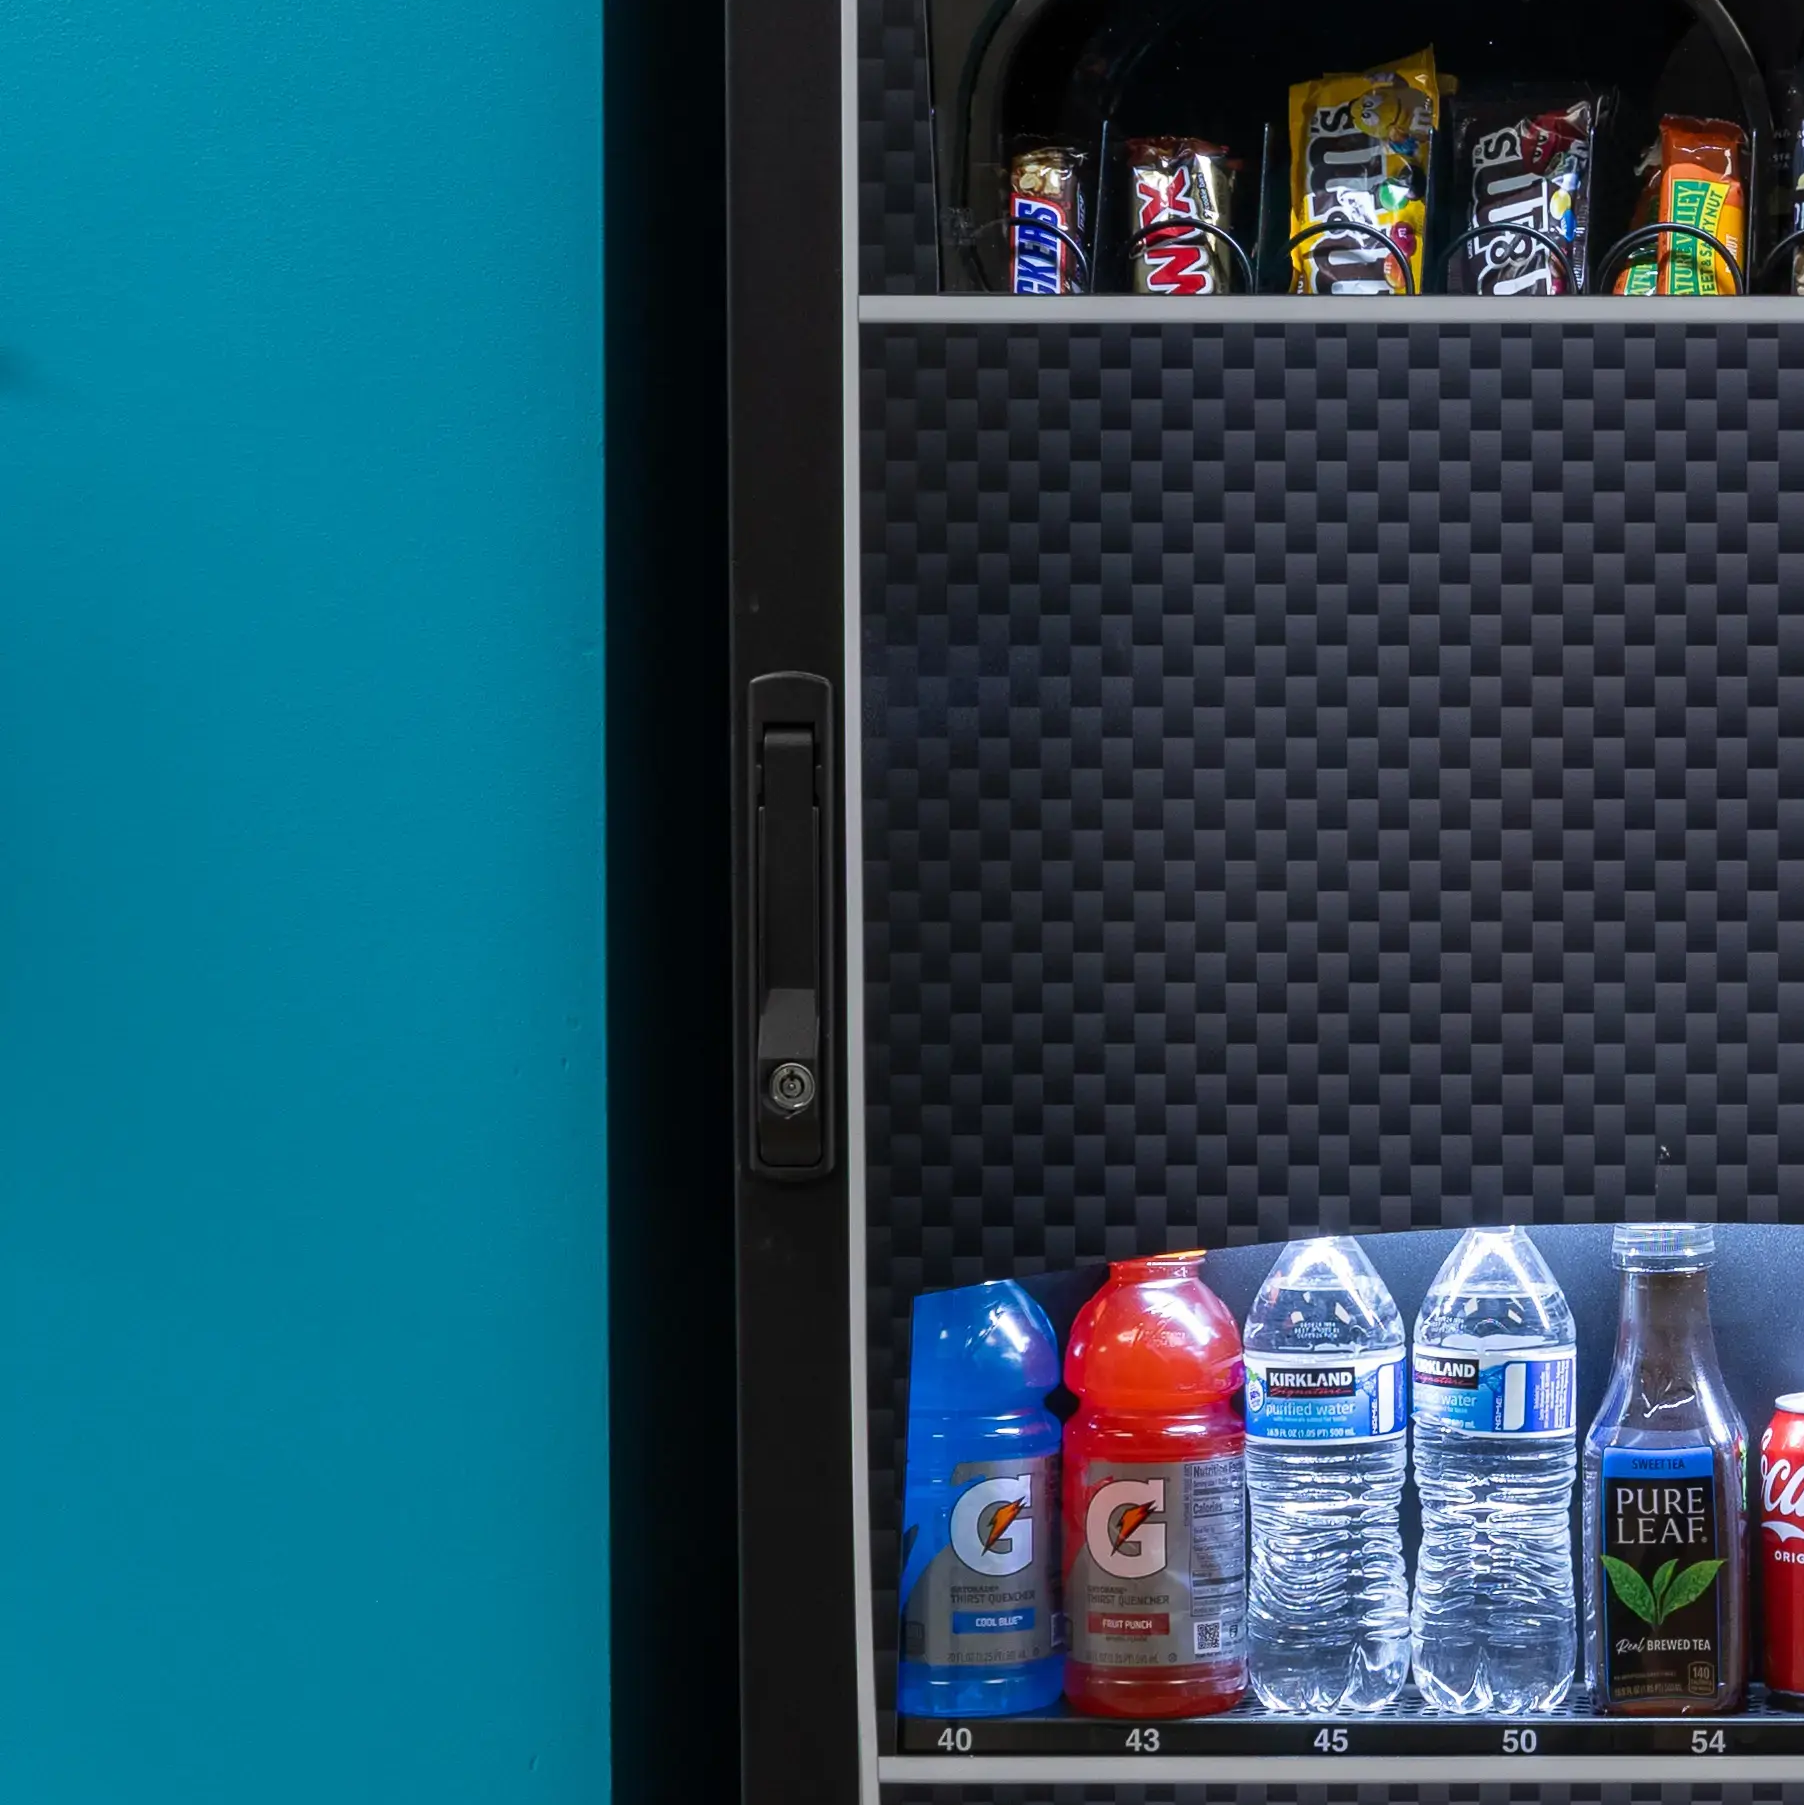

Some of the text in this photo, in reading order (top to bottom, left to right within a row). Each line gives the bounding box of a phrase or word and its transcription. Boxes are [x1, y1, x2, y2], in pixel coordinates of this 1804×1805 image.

[1707, 189, 1723, 217] NUT
[1269, 1371, 1353, 1387] KIRKLAND
[1266, 1402, 1356, 1416] purified water
[1441, 1395, 1477, 1407] water
[1287, 1428, 1298, 1437] OZ
[1329, 1427, 1344, 1437] 500
[1631, 1457, 1686, 1471] SWEET TEA
[1193, 1502, 1223, 1515] Calories
[1616, 1486, 1705, 1515] PURE
[950, 1473, 1033, 1577] G
[1086, 1478, 1168, 1579] G
[1616, 1516, 1705, 1544] LEAF
[951, 1590, 1036, 1604] THIRST QUENCHER
[1118, 1595, 1170, 1607] QUENCHER
[975, 1617, 997, 1627] COOL
[1102, 1619, 1152, 1629] FRUIT PUNCH
[1615, 1637, 1712, 1655] Real BREWED TEA
[1692, 1666, 1710, 1680] 140
[937, 1728, 973, 1752] 40
[1125, 1728, 1161, 1752] 43
[1314, 1729, 1349, 1753] 45
[1502, 1729, 1537, 1753] 50
[1691, 1730, 1726, 1754] 54
